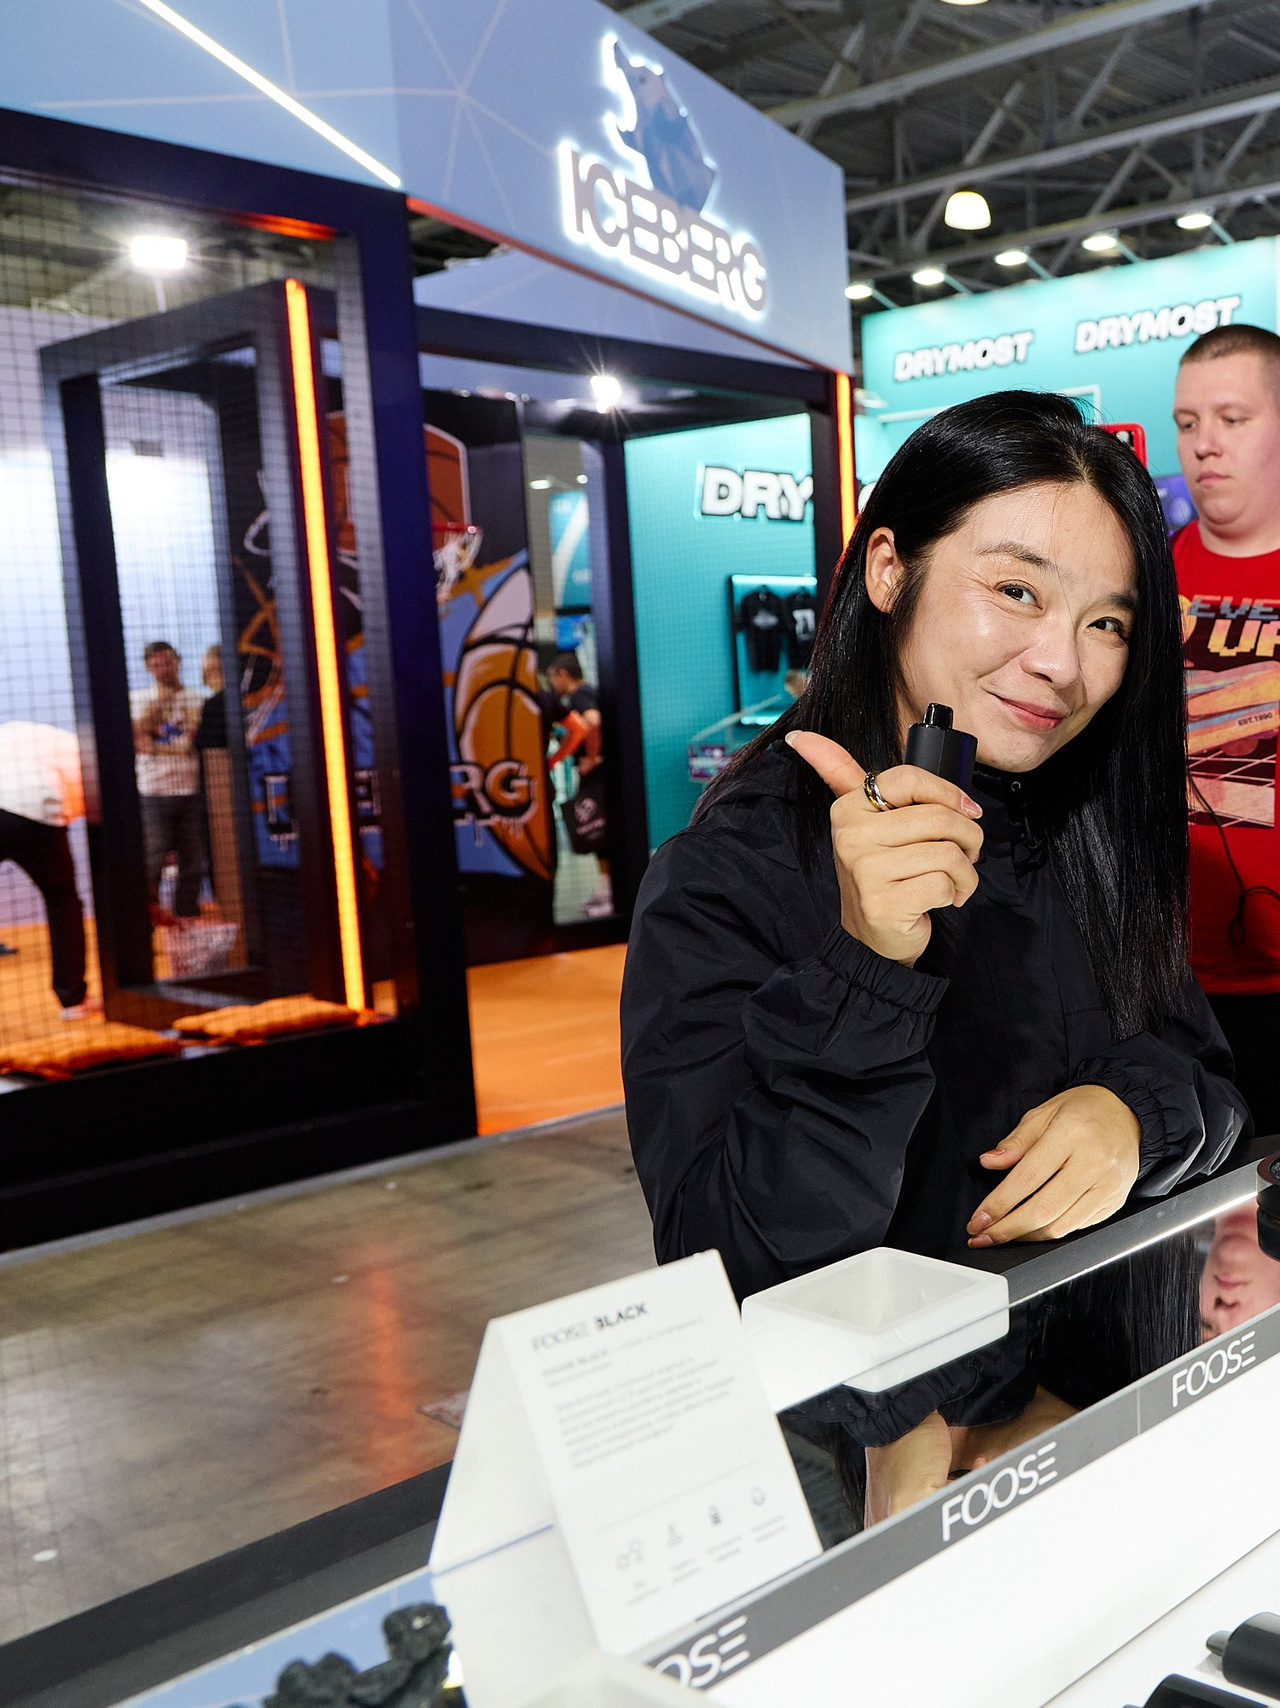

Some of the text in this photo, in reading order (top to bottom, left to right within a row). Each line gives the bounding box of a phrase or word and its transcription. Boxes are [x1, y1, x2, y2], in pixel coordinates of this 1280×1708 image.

[565, 146, 768, 313] ICEBERG
[893, 330, 1034, 381] DRYMOST
[1074, 296, 1241, 353] DRYMOST
[1172, 1331, 1256, 1407] FOOSE
[942, 1442, 1058, 1541] FOOSE
